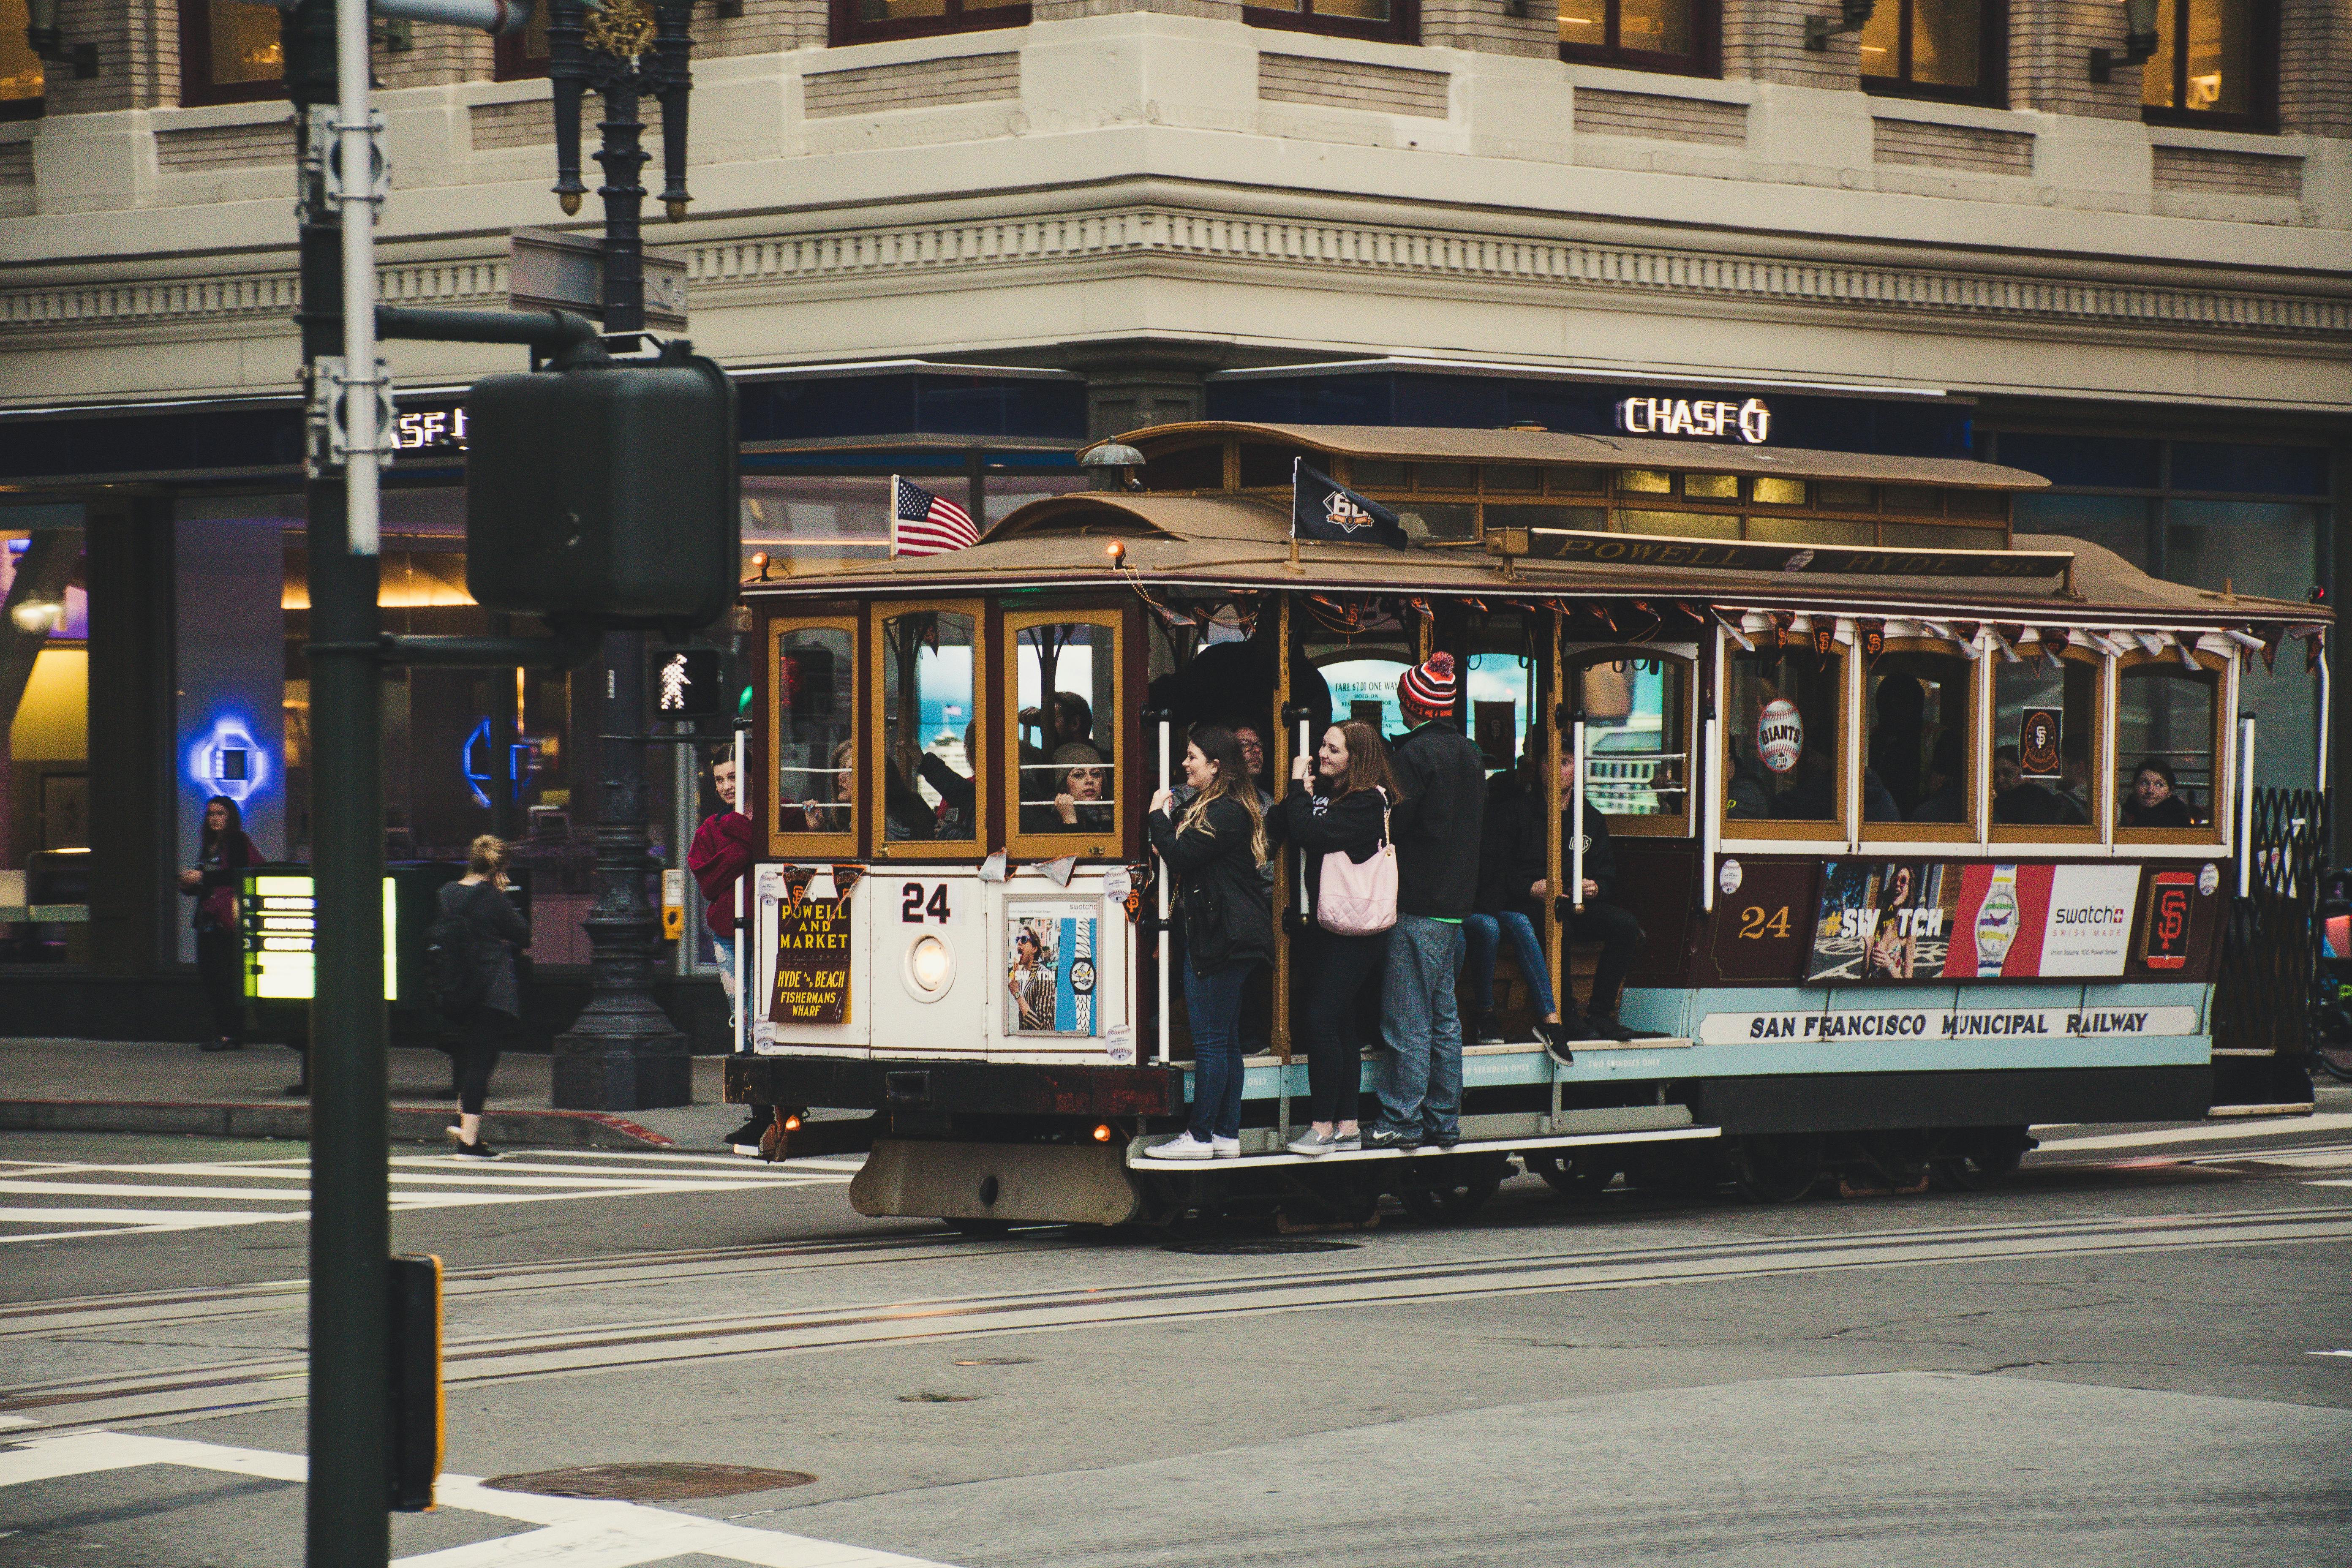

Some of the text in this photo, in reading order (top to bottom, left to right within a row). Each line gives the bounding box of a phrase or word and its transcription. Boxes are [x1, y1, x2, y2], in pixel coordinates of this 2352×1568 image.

[1554, 539, 1749, 566] POWELL
[1843, 555, 1964, 573] HYDE
[1335, 681, 1398, 692] FARE $7.00 ONE WAY
[1761, 724, 1801, 745] GIANTS
[902, 882, 951, 924] 24
[782, 905, 847, 920] POWELL
[2055, 905, 2113, 924] swatch
[2158, 890, 2187, 950] SF
[799, 920, 830, 932] AND
[1739, 906, 1791, 939] 24
[780, 934, 848, 948] MARKET
[2053, 929, 2085, 937] SWISS
[777, 970, 845, 988] HYDE AND BEACH
[780, 991, 836, 1004] FISHERMANS
[792, 1004, 822, 1017] WHARF
[1750, 1013, 2149, 1038] SAN FRANCISCO MUNICIPAL RAILWAY
[1588, 1060, 1604, 1069] TWO
[1642, 1058, 1661, 1067] ONLY
